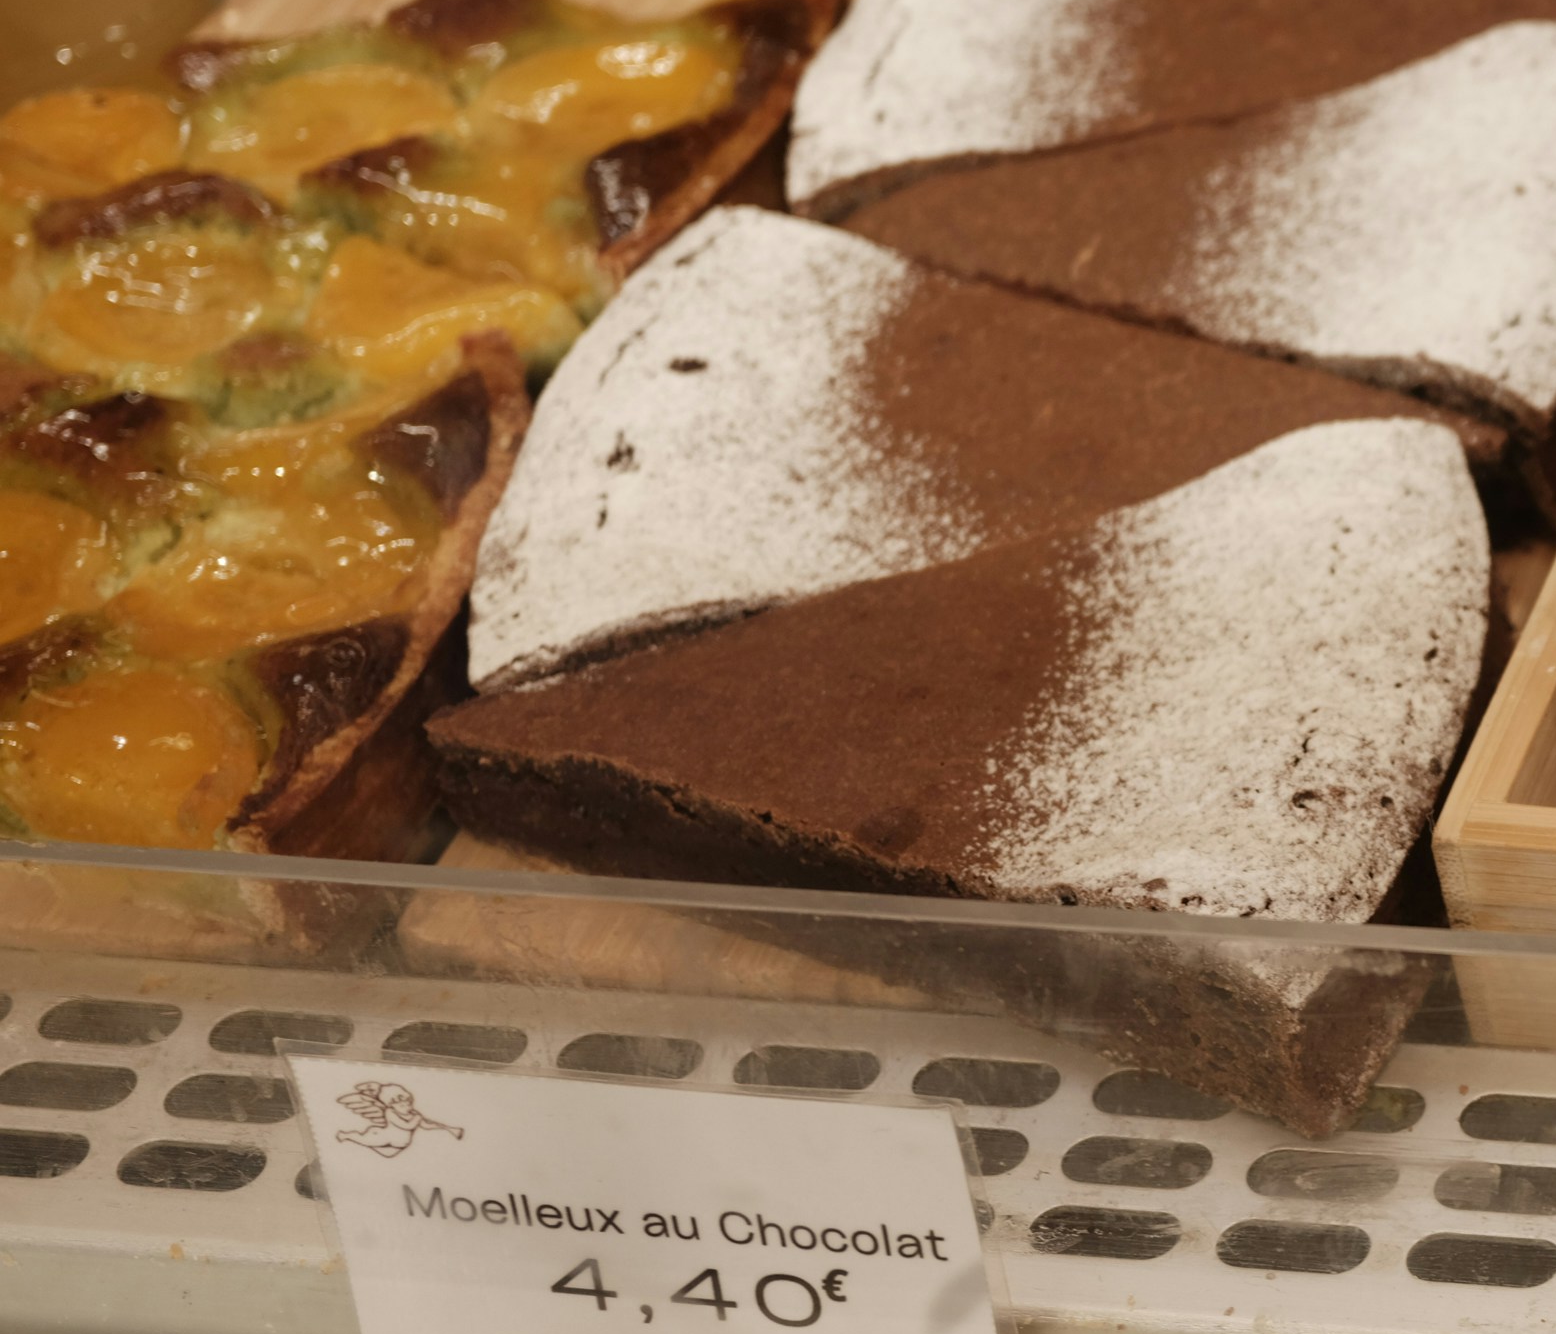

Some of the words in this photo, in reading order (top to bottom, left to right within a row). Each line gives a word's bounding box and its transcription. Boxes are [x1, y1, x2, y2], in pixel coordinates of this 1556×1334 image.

[401, 1183, 626, 1235] Moelleux
[641, 1211, 701, 1241] au
[717, 1210, 950, 1263] Chocolat
[549, 1257, 850, 1329] 4,40€
